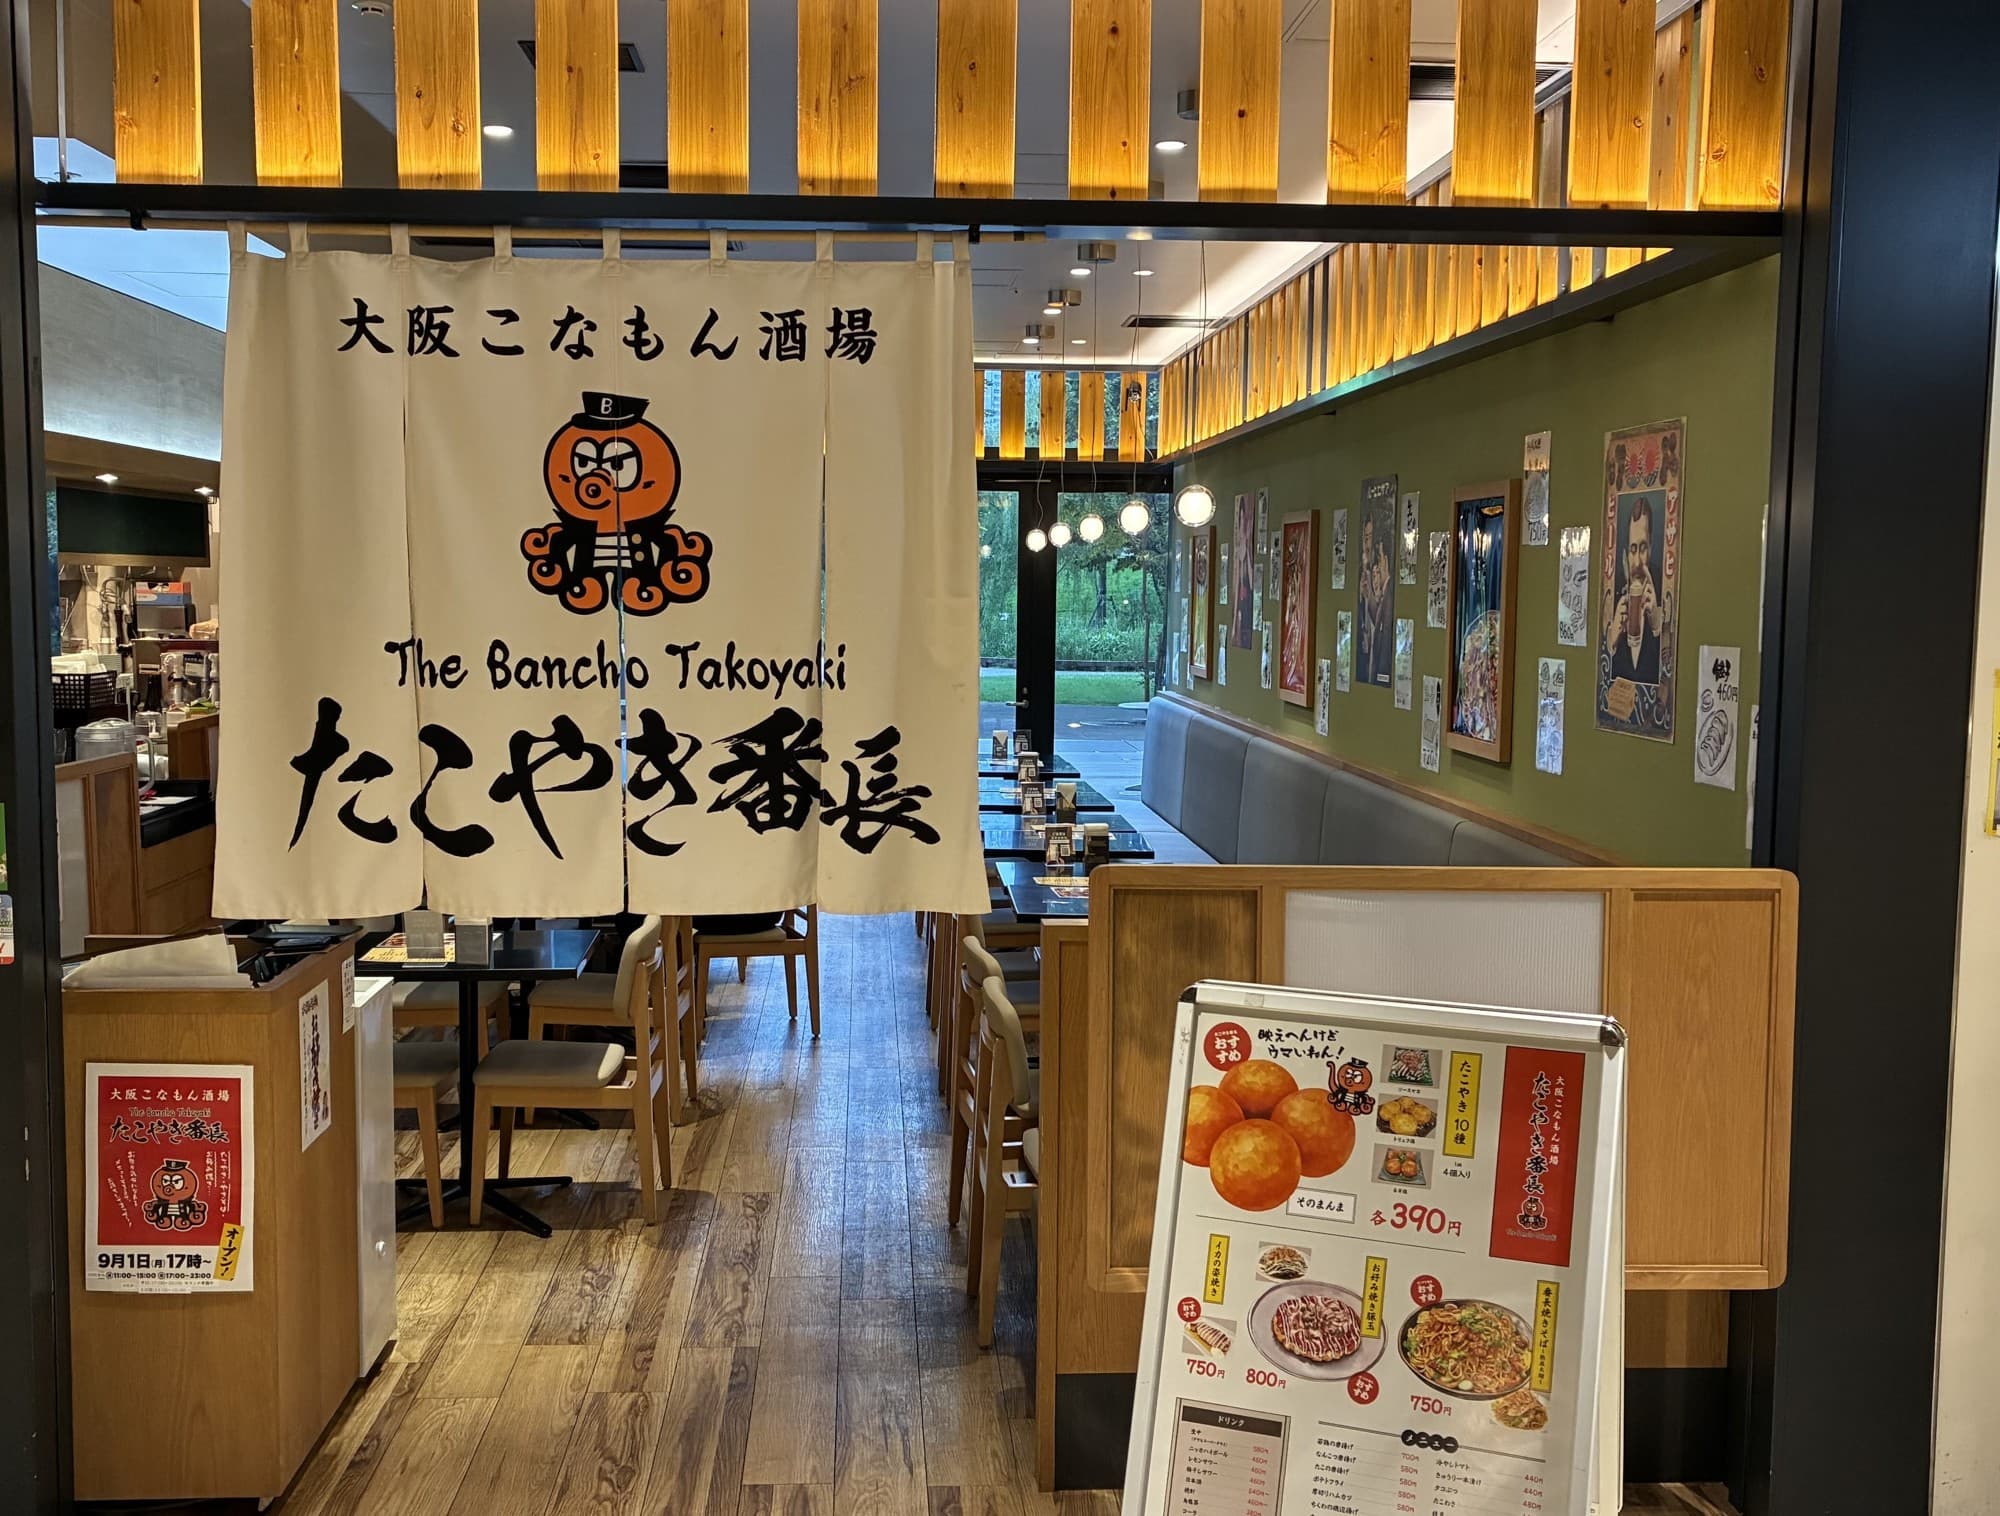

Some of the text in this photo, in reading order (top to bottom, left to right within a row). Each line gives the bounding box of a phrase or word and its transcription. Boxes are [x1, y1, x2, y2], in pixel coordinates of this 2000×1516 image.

[337, 297, 879, 364] 大阪こなもん酒場
[600, 397, 613, 414] B
[384, 639, 846, 700] The Bancho Takoyaki
[288, 697, 941, 861] たこやき番長
[1258, 1028, 1339, 1043] 映えへんけど
[110, 1087, 230, 1102] 大阪こなもん酒場
[109, 1116, 230, 1144] たこやき番長
[1549, 1075, 1566, 1166] 大阪こなもん酒場
[1523, 1071, 1552, 1195] たこやき番長
[1296, 1196, 1345, 1213] そのまんま
[1186, 1358, 1225, 1379] 750円
[1245, 1368, 1286, 1389] 800円
[1410, 1394, 1452, 1416] 750円
